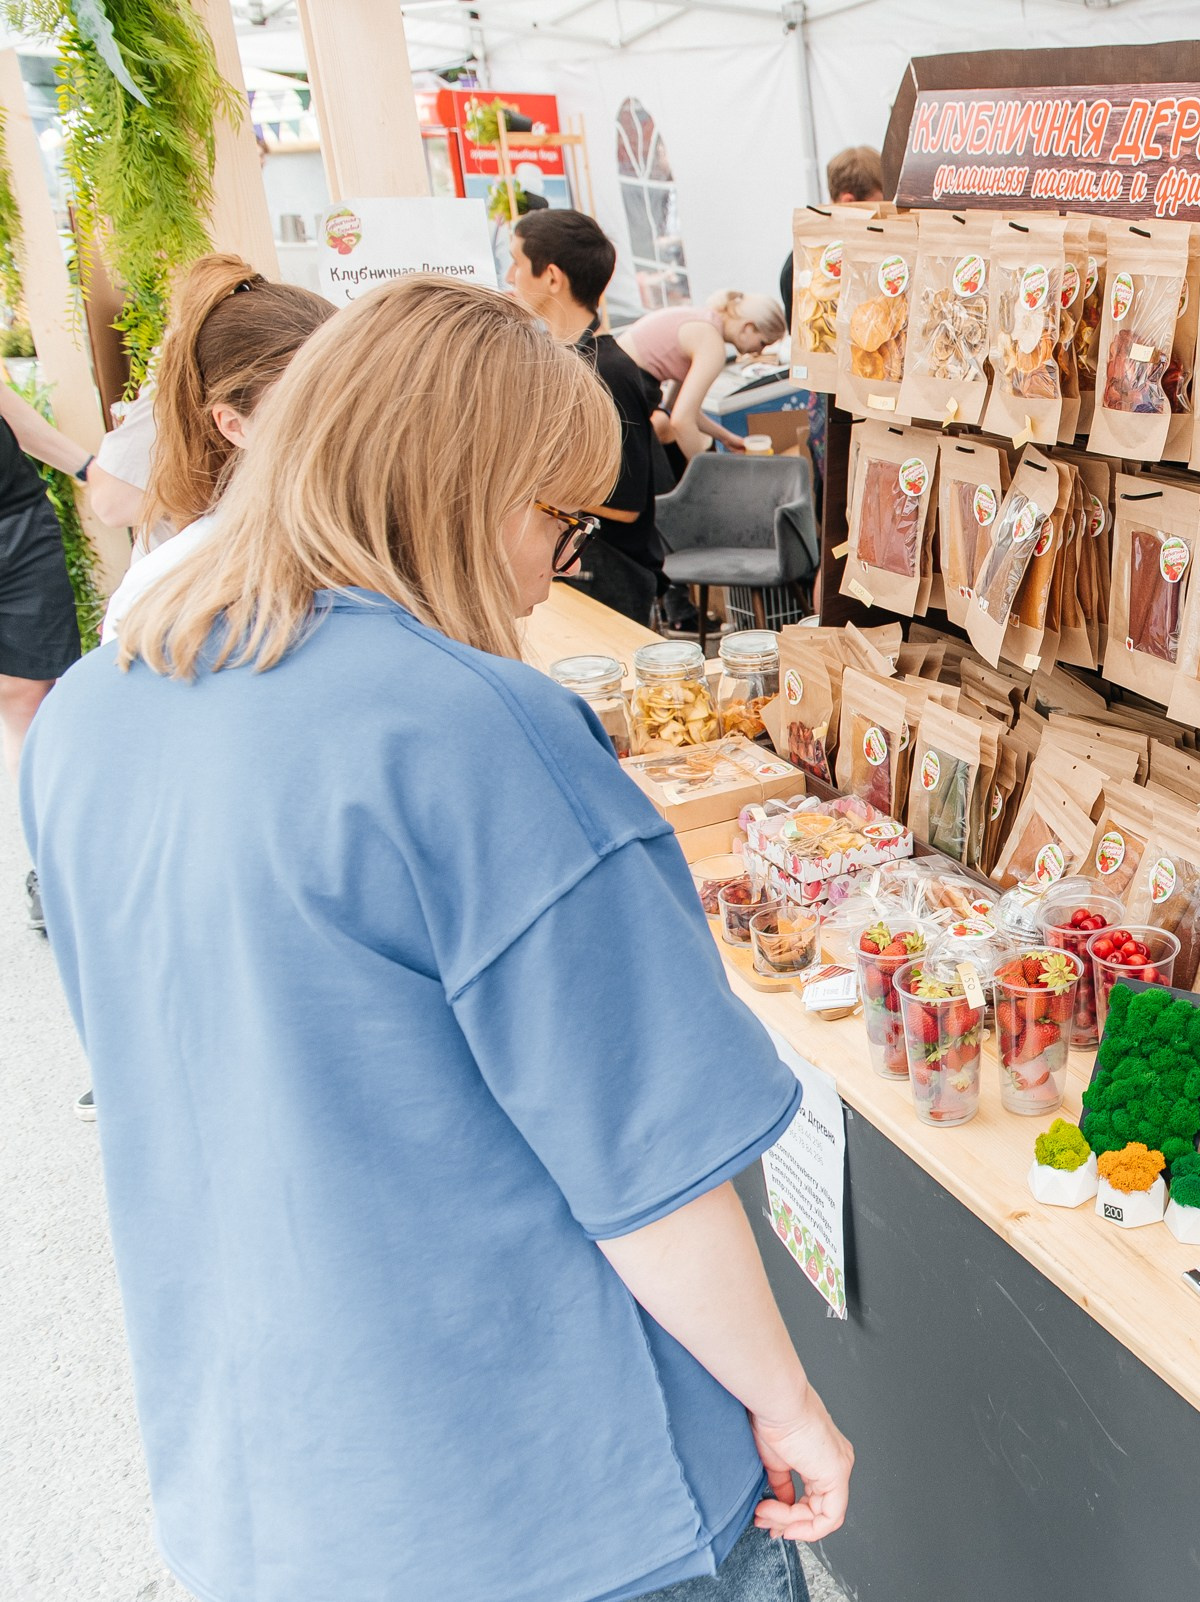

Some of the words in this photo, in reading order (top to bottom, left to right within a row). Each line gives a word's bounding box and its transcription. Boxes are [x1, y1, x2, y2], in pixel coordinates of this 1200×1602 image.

[911, 97, 1110, 157] КЛУБНИЧНАЯ
[932, 164, 1029, 201] домашняя
[1031, 167, 1122, 200] пастила
[1129, 171, 1148, 199] и
[330, 266, 415, 284] Клубничная
[963, 972, 975, 991] 150
[1105, 1205, 1123, 1220] 200
